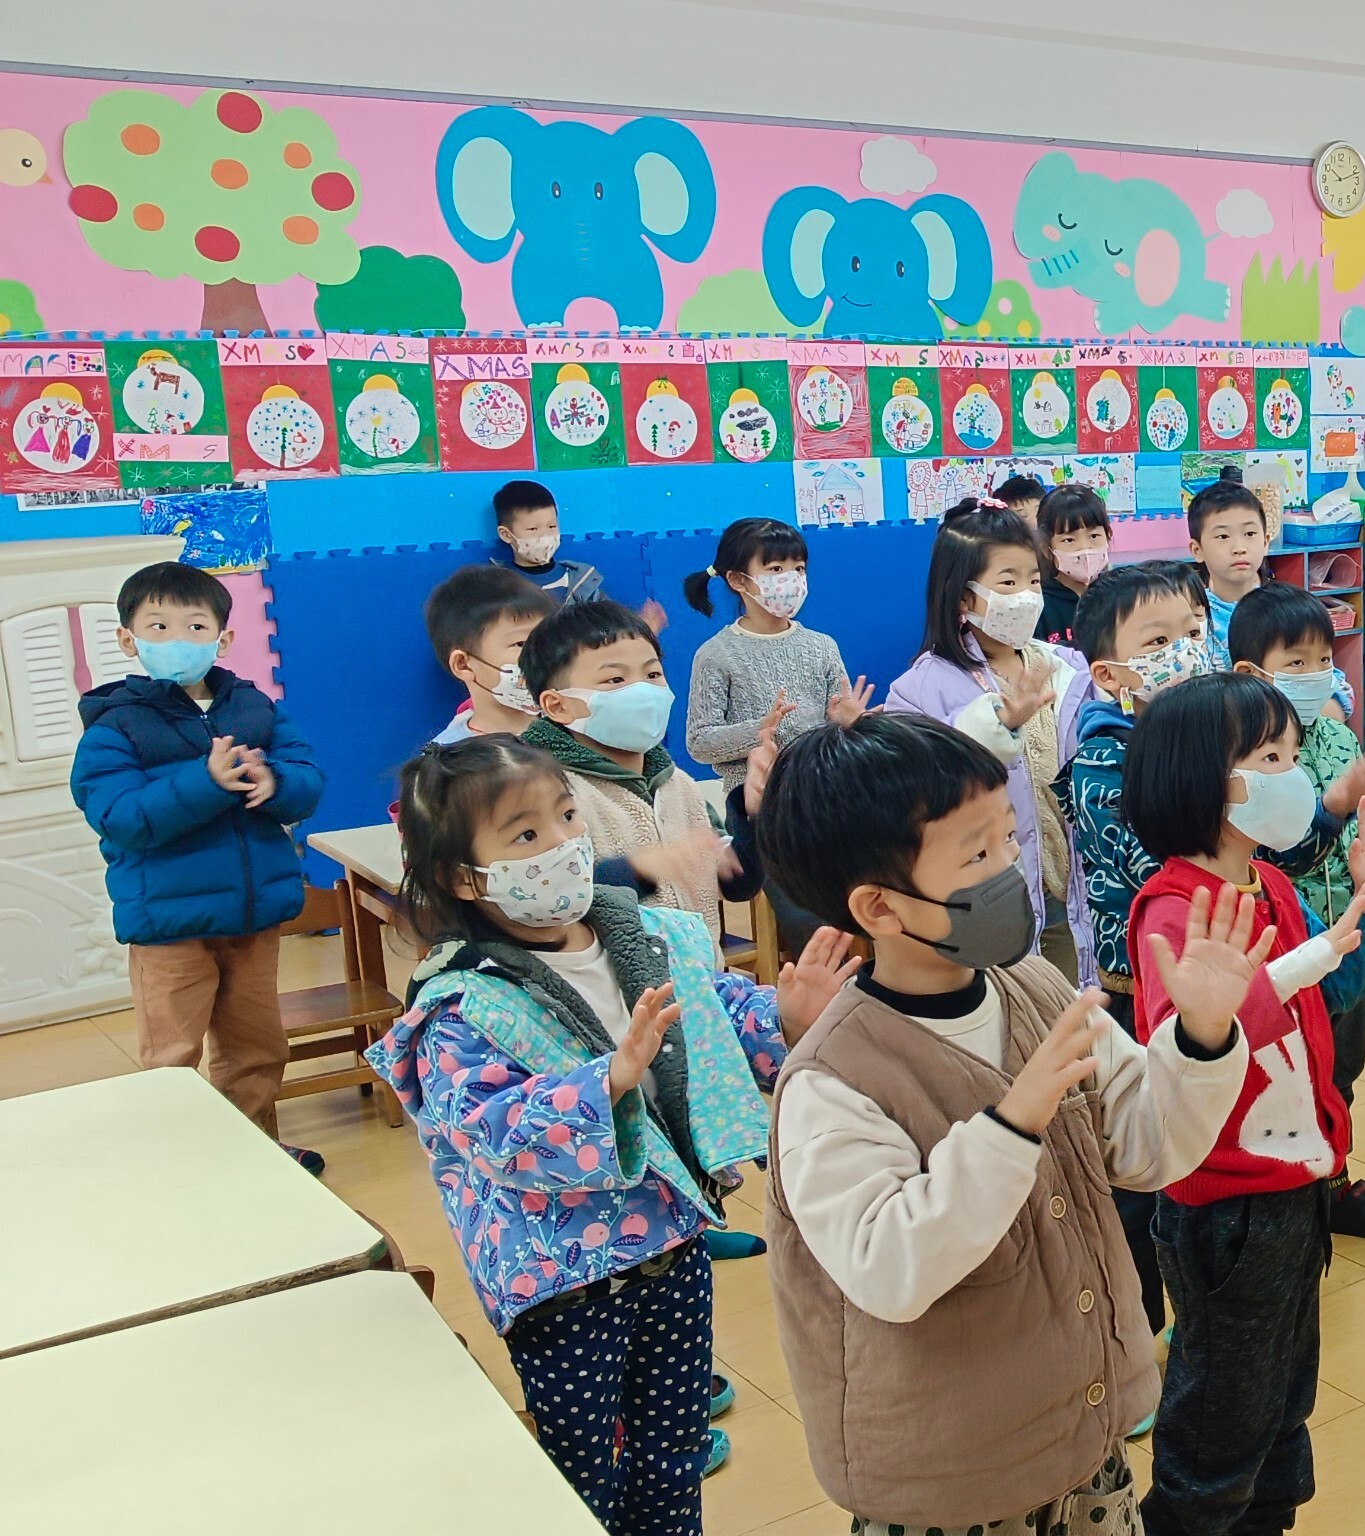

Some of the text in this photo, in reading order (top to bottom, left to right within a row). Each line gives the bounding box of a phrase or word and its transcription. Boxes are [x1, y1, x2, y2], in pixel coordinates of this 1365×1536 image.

[1330, 155, 1336, 164] 11
[1338, 153, 1345, 161] 12
[1324, 163, 1331, 173] 10
[1352, 165, 1358, 174] 2
[1321, 174, 1327, 183] 9
[1354, 176, 1360, 186] 3
[1323, 185, 1329, 195] 8
[1352, 187, 1357, 196] 4
[1330, 194, 1335, 203] 7
[1337, 197, 1343, 206] 6
[1346, 195, 1351, 204] 5
[330, 337, 407, 362] XMAS
[791, 345, 848, 364] XMAS
[1140, 347, 1186, 365] XMAS
[435, 356, 530, 380] XMAS
